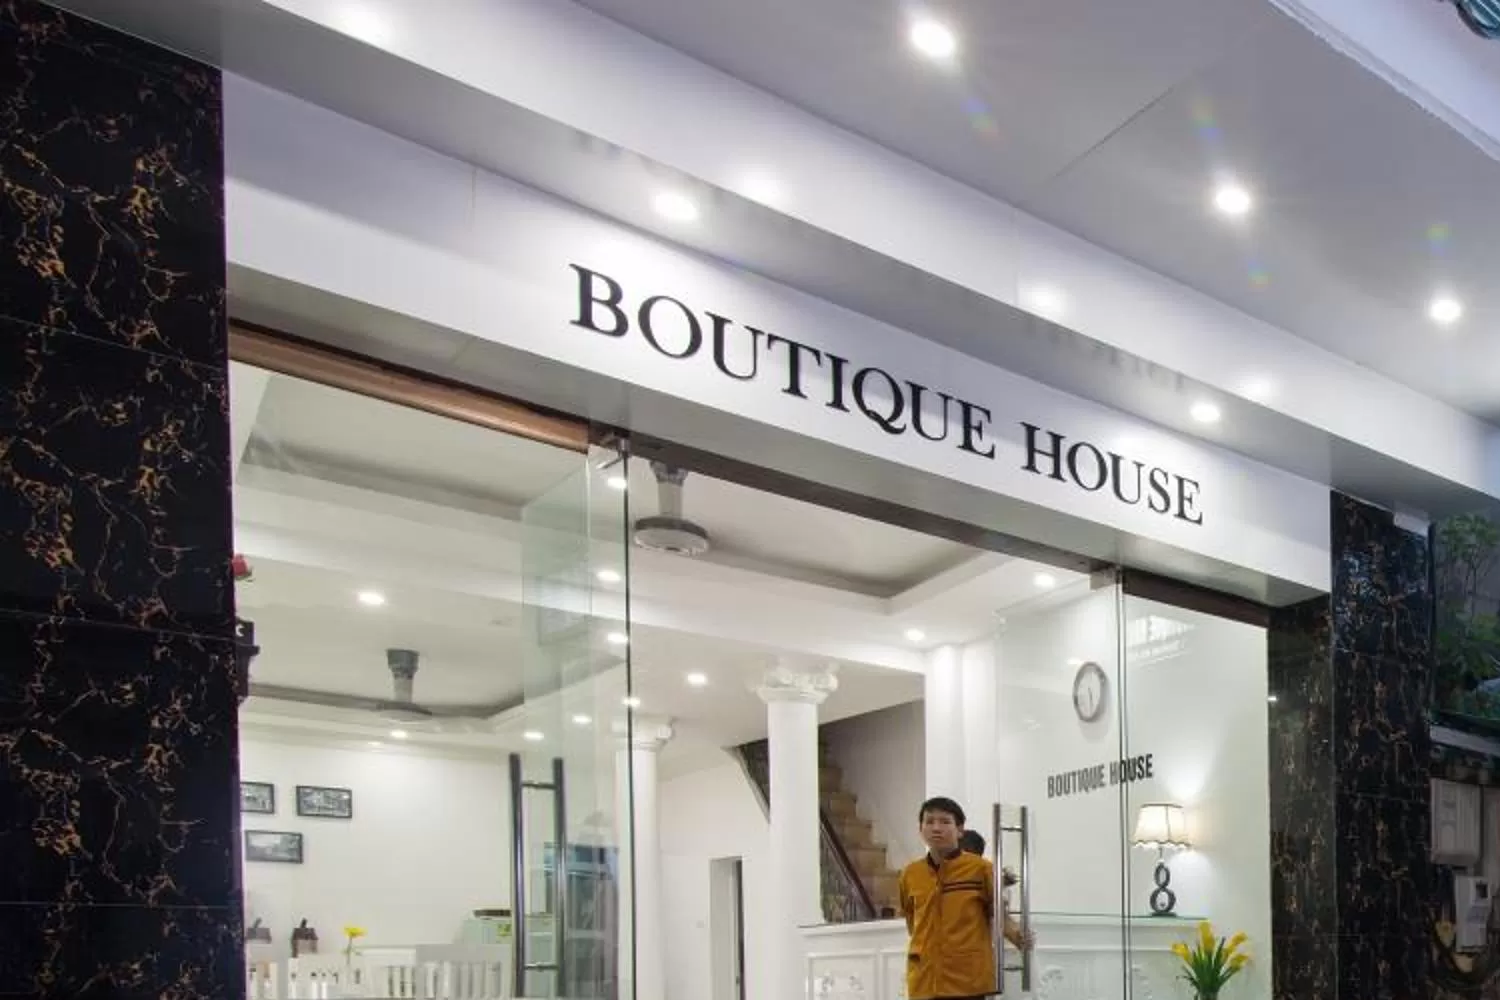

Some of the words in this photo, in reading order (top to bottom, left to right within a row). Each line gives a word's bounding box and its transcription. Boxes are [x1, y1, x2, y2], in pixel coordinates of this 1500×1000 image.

[569, 263, 996, 461] BOUTIQUE
[1020, 421, 1204, 526] HOUSE
[1047, 764, 1105, 799] BOUTIQUE
[1109, 753, 1153, 785] HOUSE
